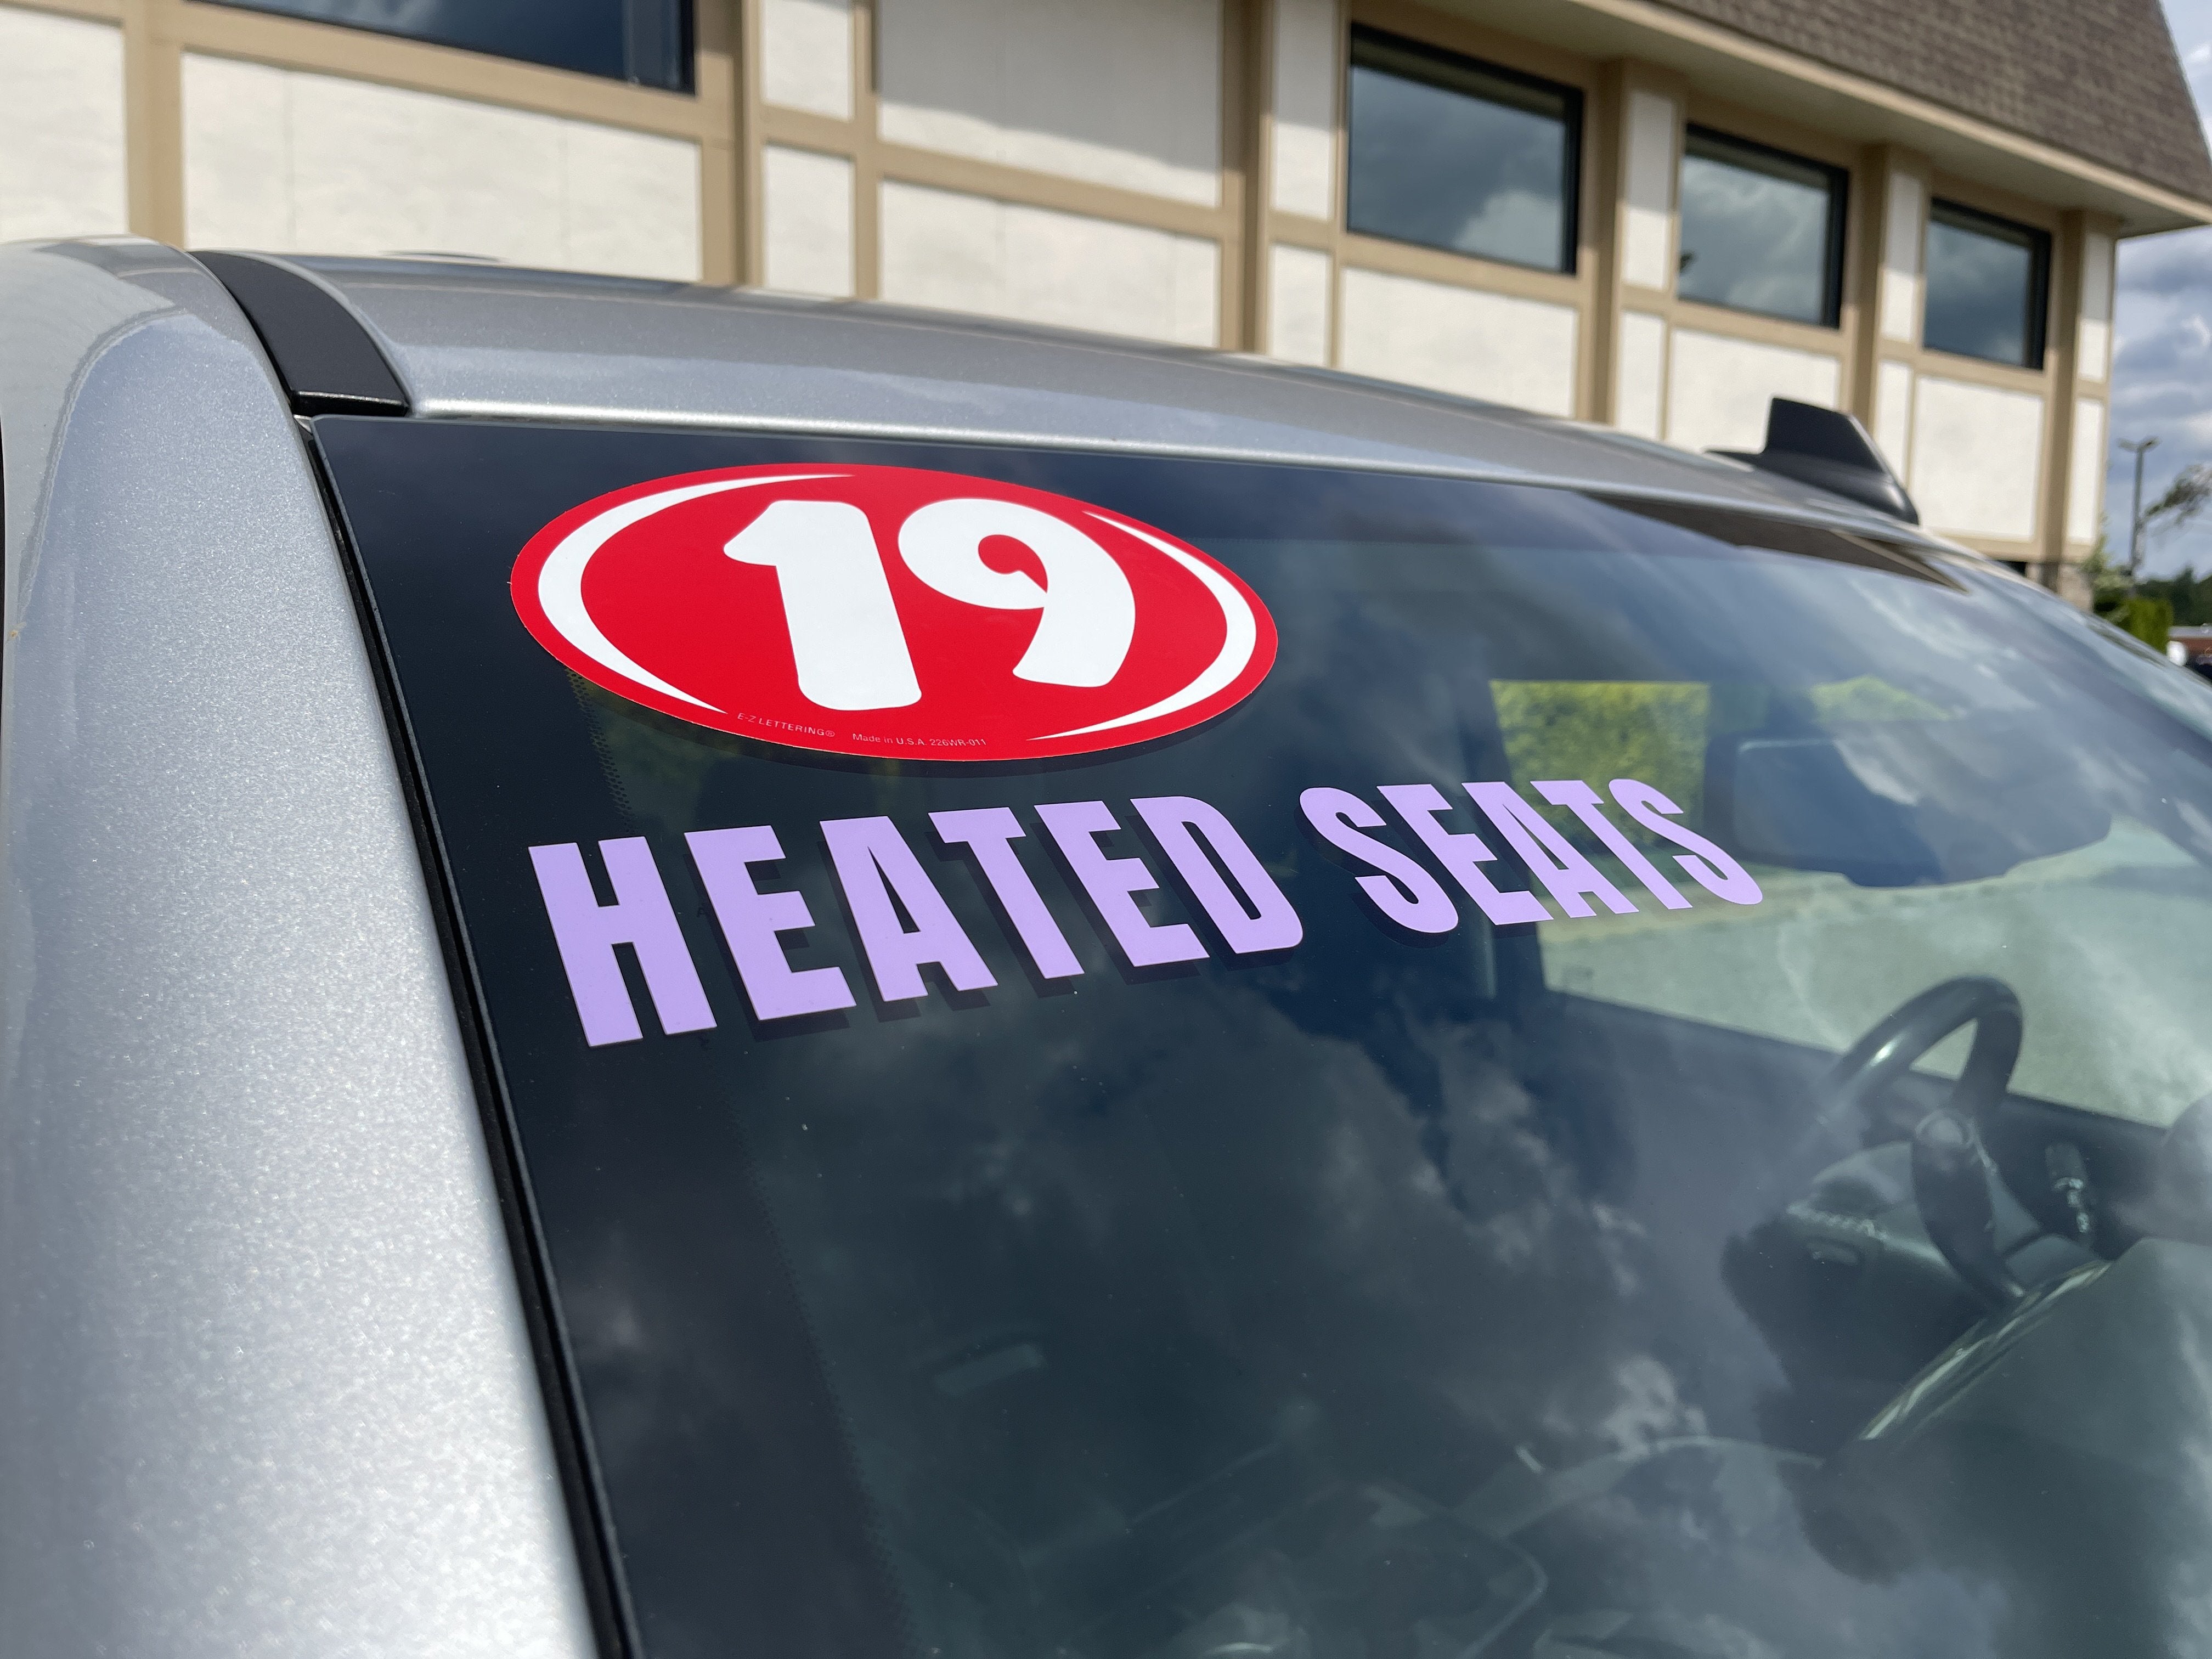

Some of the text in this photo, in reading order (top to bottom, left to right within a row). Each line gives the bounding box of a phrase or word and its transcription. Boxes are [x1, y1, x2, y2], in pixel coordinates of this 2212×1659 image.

[723, 498, 1136, 712] 19
[736, 712, 757, 724] E-Z
[851, 732, 881, 743] Made
[929, 738, 987, 747] 226WR-011
[528, 778, 1763, 1046] HEATED SEATS
